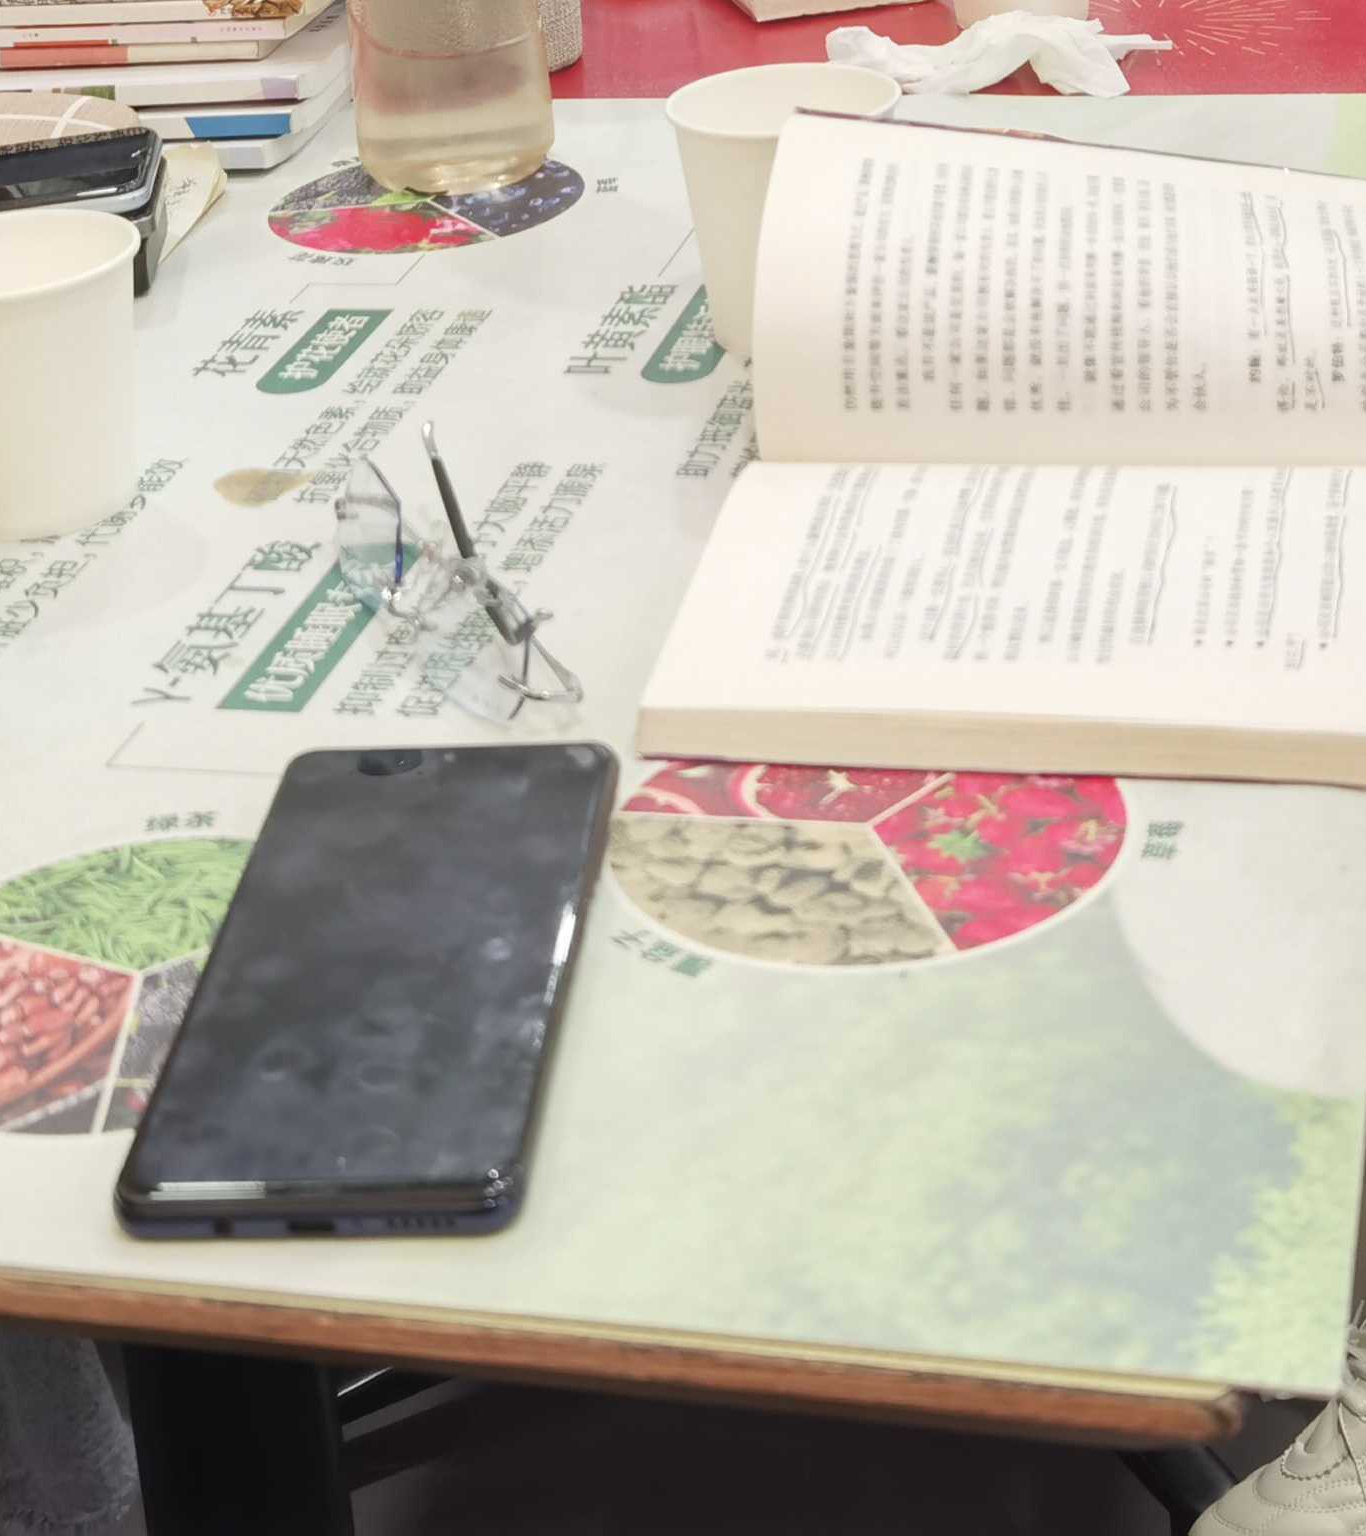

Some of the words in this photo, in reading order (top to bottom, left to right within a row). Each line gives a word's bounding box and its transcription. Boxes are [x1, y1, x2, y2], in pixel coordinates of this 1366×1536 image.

[192, 308, 305, 378] 花青素
[278, 312, 373, 381] 护花使者
[563, 284, 679, 375] 叶黄素酯
[144, 810, 219, 833] 绿茶
